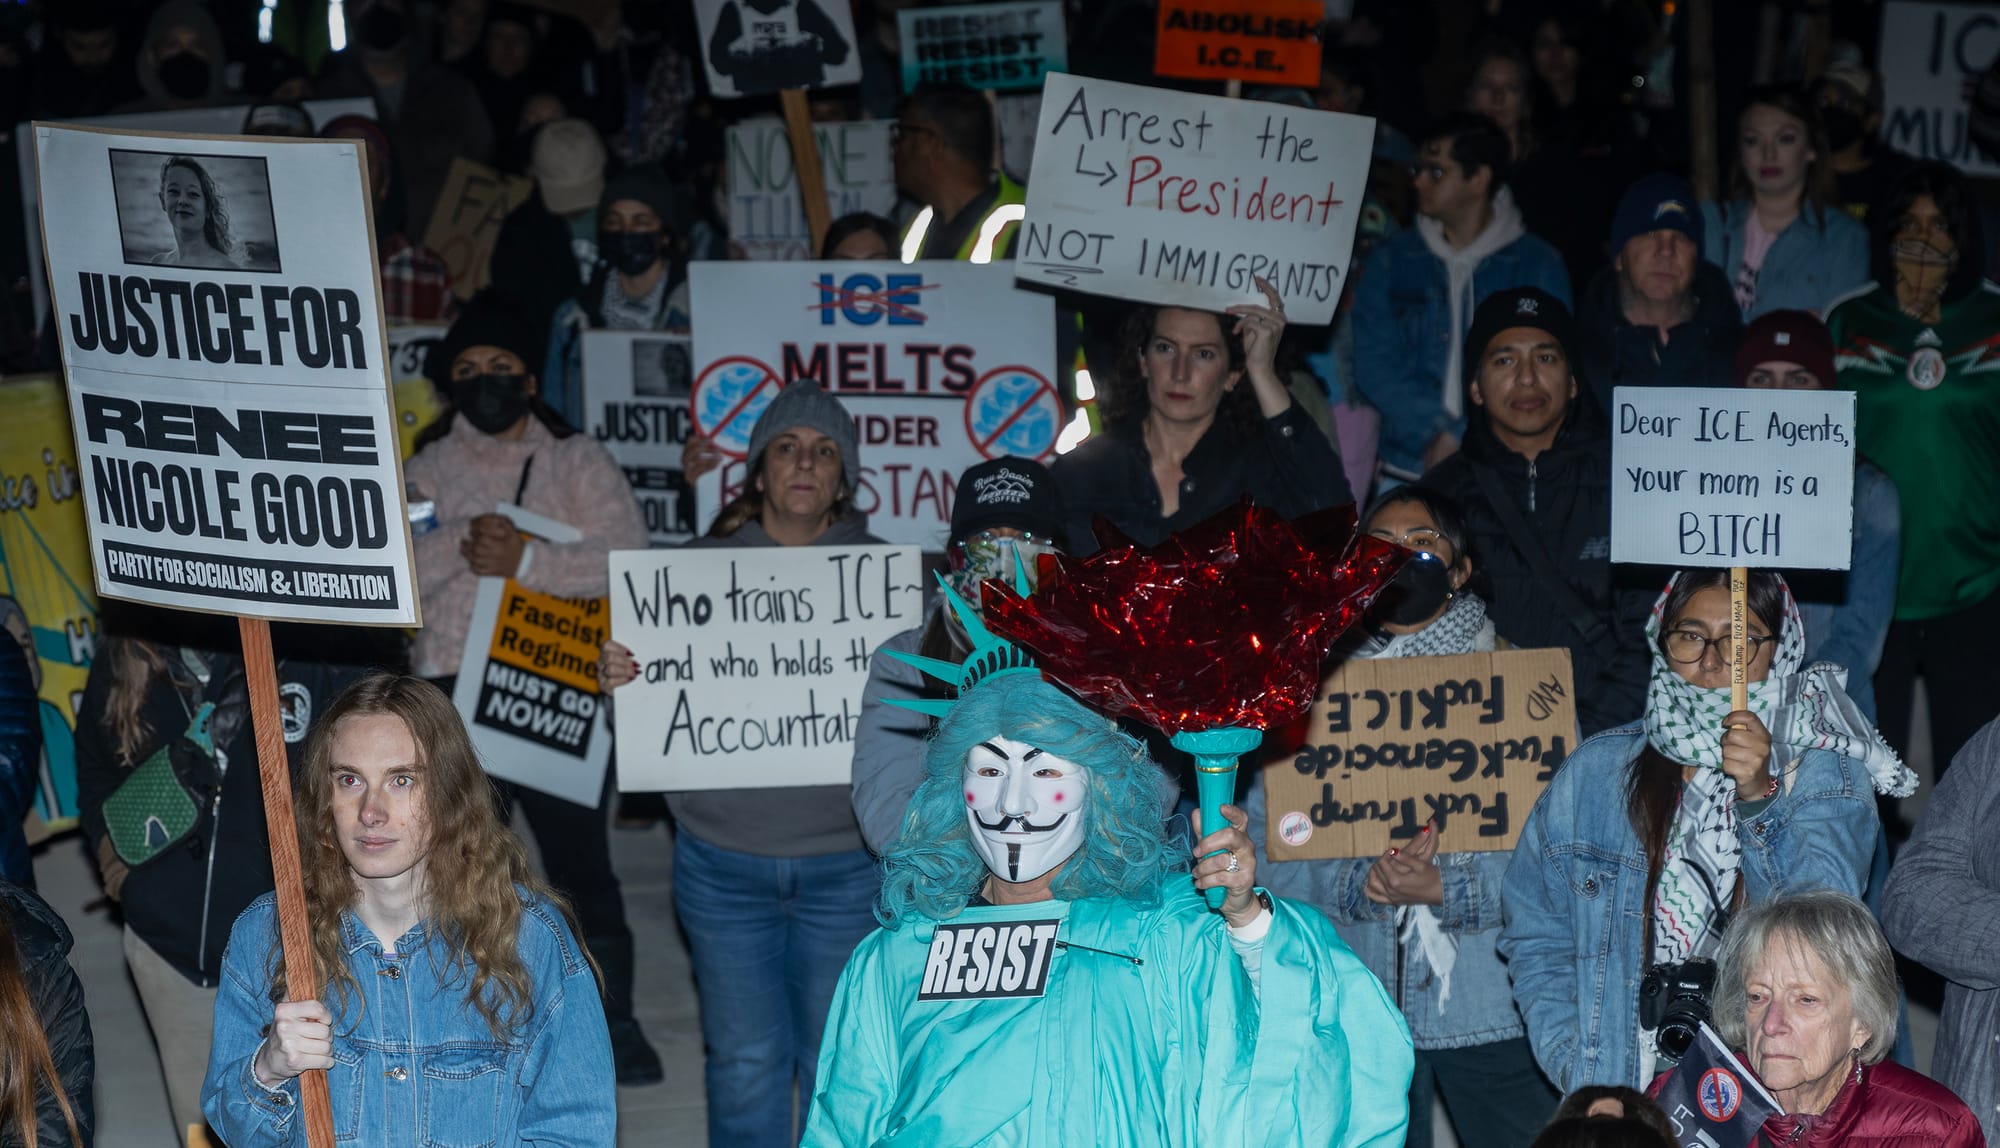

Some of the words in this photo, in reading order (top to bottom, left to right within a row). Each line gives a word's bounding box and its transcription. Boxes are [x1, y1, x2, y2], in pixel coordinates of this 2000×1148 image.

[917, 33, 1043, 60] RESIST
[1197, 44, 1287, 72] I.C.E.
[1052, 86, 1212, 148] Arrest
[1257, 115, 1319, 163] the
[1127, 155, 1344, 226] President
[1025, 222, 1114, 264] NOT
[1139, 238, 1341, 302] IMMIGRANTS
[70, 271, 260, 363] JUSTICE
[266, 286, 368, 370] FOR
[820, 273, 925, 327] ICE
[781, 342, 977, 393] MELTS
[82, 393, 380, 466] RENEE
[597, 403, 693, 444] JUSTIC
[1620, 402, 1681, 438] Dear
[1694, 407, 1754, 442] ICE
[1767, 411, 1850, 447] Agents,
[91, 455, 248, 541] NICOLE
[251, 472, 389, 550] GOOD
[1626, 467, 1688, 493] your
[1699, 470, 1760, 498] mom
[1775, 470, 1793, 496] is
[1802, 476, 1818, 496] a
[1679, 511, 1781, 557] BITCH
[108, 548, 153, 579] PARTY
[154, 557, 185, 584] FOR
[186, 562, 267, 594] SOCIALISM
[271, 570, 292, 596] &
[294, 571, 390, 601] LIBERATION
[623, 566, 713, 627] Who
[726, 561, 815, 625] trains
[508, 595, 604, 648] Fascist
[500, 625, 600, 680] Regime
[645, 643, 694, 684] and
[710, 641, 759, 679] who
[771, 638, 833, 678] holds
[845, 636, 873, 673] th
[485, 690, 587, 746] NOW!!!
[486, 663, 557, 705] MUST
[560, 689, 596, 719] GO
[1527, 673, 1567, 721] AND
[662, 687, 861, 758] Accountab
[1294, 738, 1479, 783] Genocide
[1310, 783, 1430, 839] Trump
[921, 924, 1057, 994] RESIST
